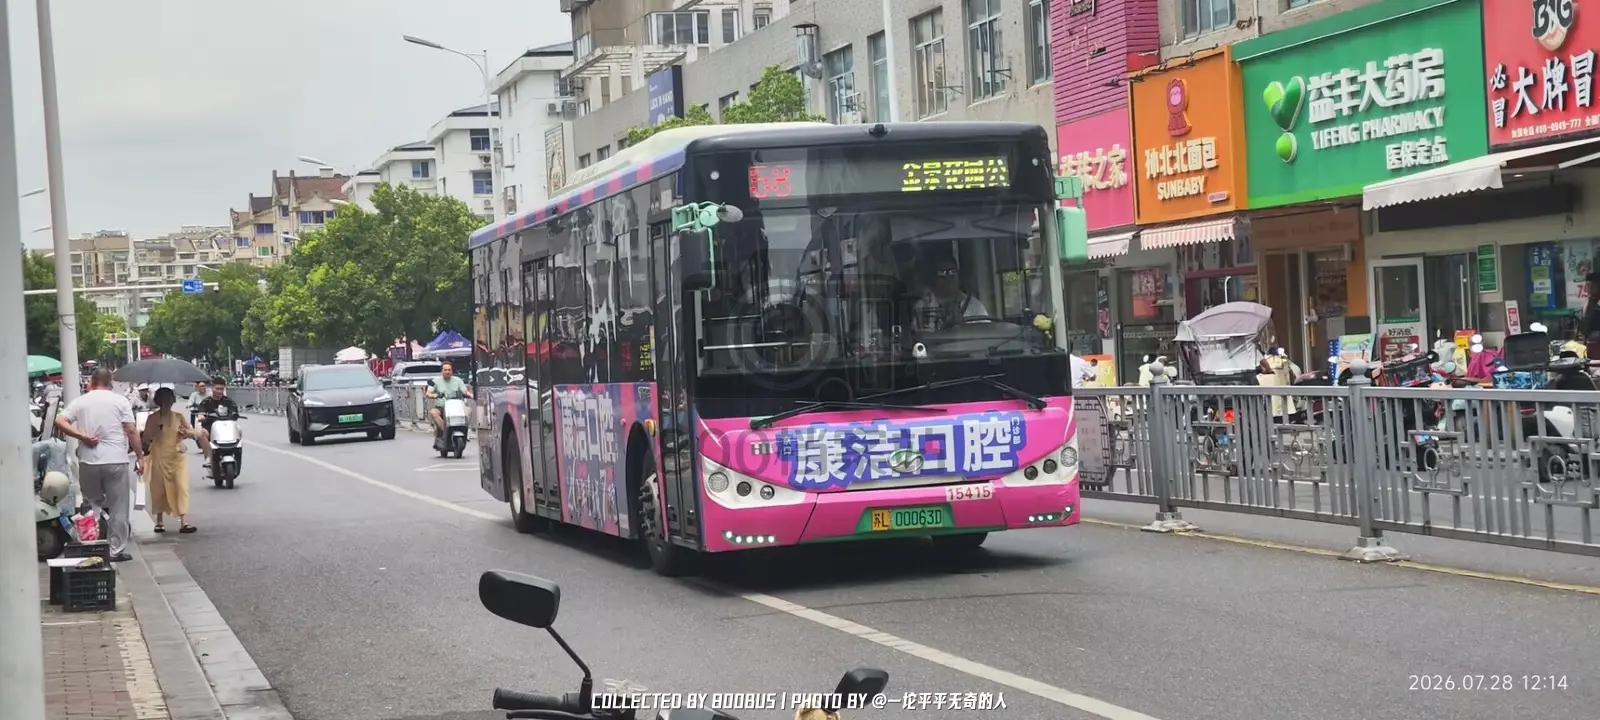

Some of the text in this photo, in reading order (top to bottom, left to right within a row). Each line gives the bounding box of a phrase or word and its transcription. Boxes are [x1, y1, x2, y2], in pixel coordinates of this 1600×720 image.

[1307, 48, 1446, 124] 益丰大药房
[1510, 49, 1596, 118] 大牌冒
[1311, 106, 1445, 150] YIFENG PHARMACY
[1145, 137, 1217, 179] 孙北北面包
[1386, 136, 1448, 170] 医保定点
[1158, 176, 1205, 199] SUNBABY
[562, 389, 618, 463] 康洁口腔
[795, 416, 1013, 484] 康洁口腔
[948, 486, 991, 500] 15415
